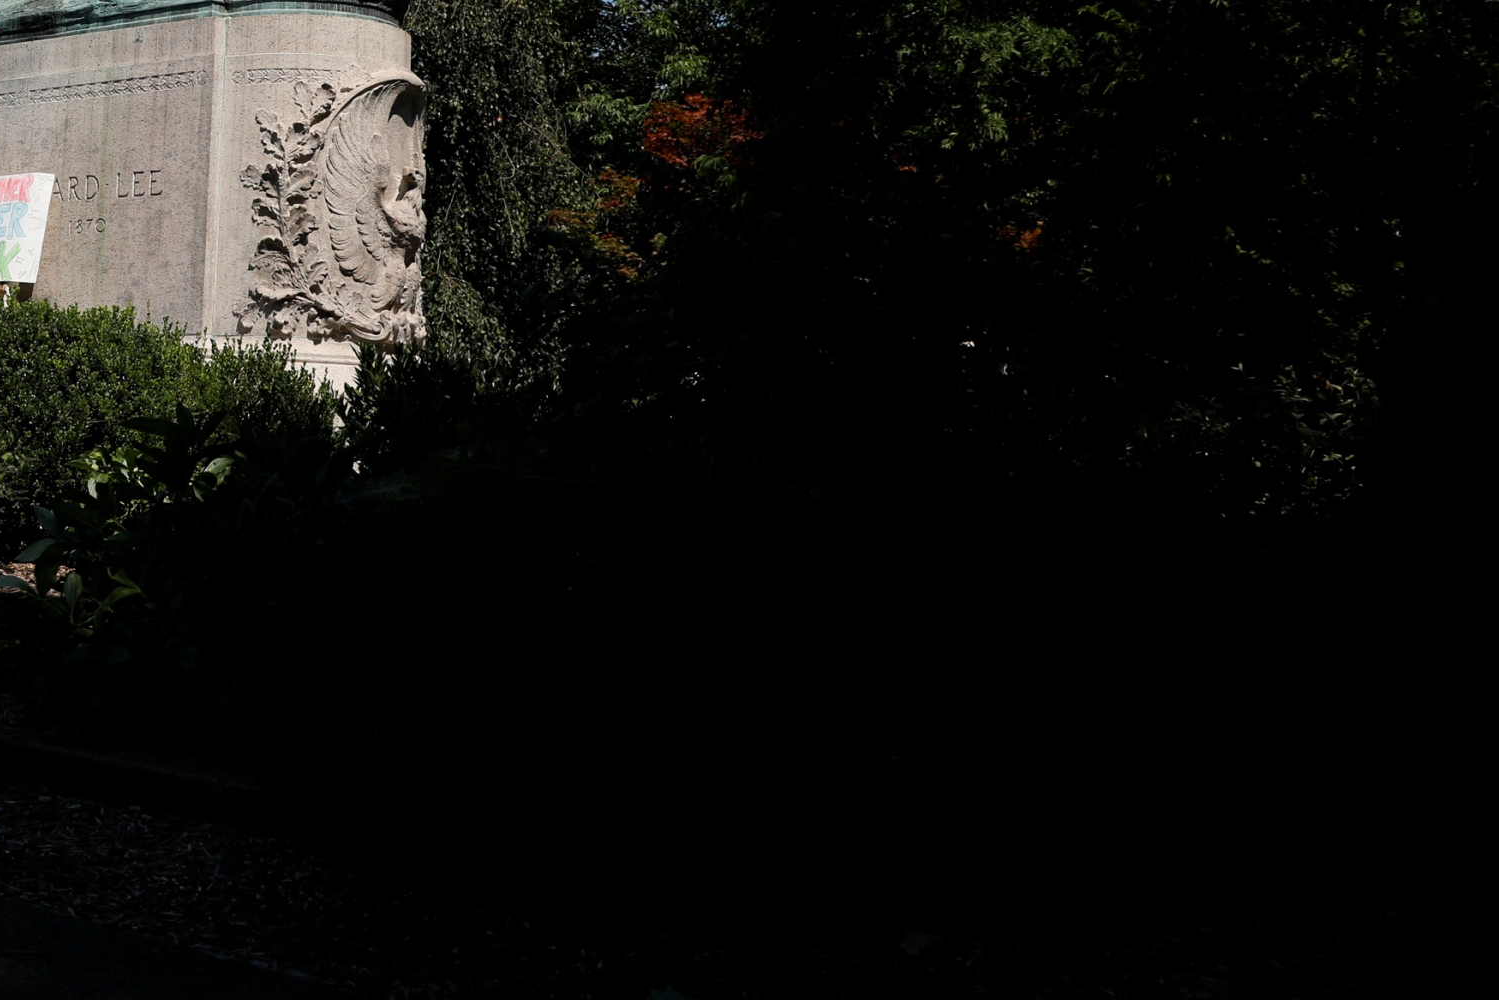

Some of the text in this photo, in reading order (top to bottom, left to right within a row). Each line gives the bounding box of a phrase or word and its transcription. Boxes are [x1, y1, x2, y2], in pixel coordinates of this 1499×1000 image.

[52, 174, 100, 203] ARD
[115, 169, 163, 199] LEE
[68, 217, 107, 236] 1870
